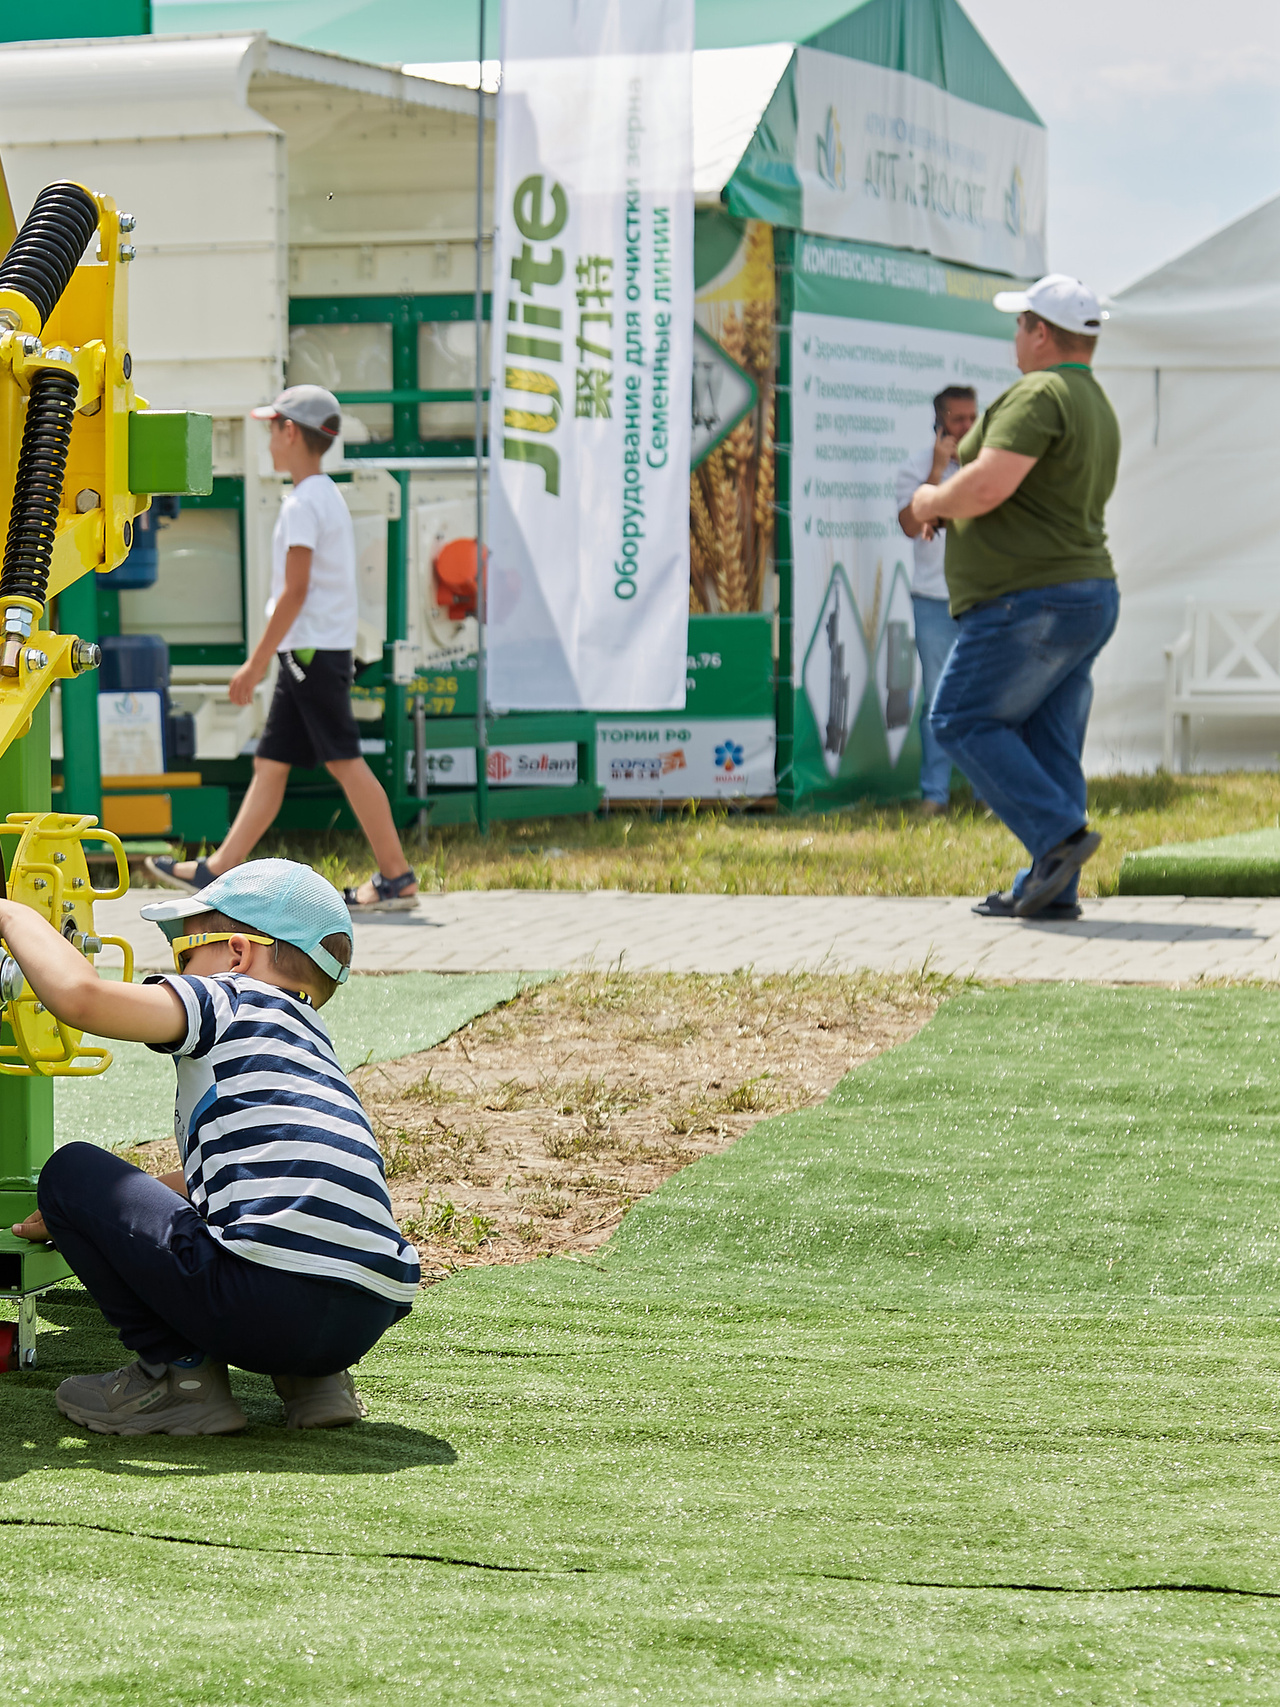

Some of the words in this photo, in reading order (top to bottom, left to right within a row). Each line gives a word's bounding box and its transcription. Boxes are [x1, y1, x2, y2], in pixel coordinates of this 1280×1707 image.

[627, 77, 644, 168] зерна
[625, 178, 641, 301] очистки
[652, 206, 671, 303] линии
[802, 244, 884, 284] КОМПЛЕКСНЫЕ
[575, 255, 614, 419] 聚力特
[626, 311, 646, 366] для
[646, 311, 671, 469] Семенные
[614, 375, 645, 601] Оборудование
[599, 728, 660, 743] ТОРИИ
[665, 727, 692, 743] РФ
